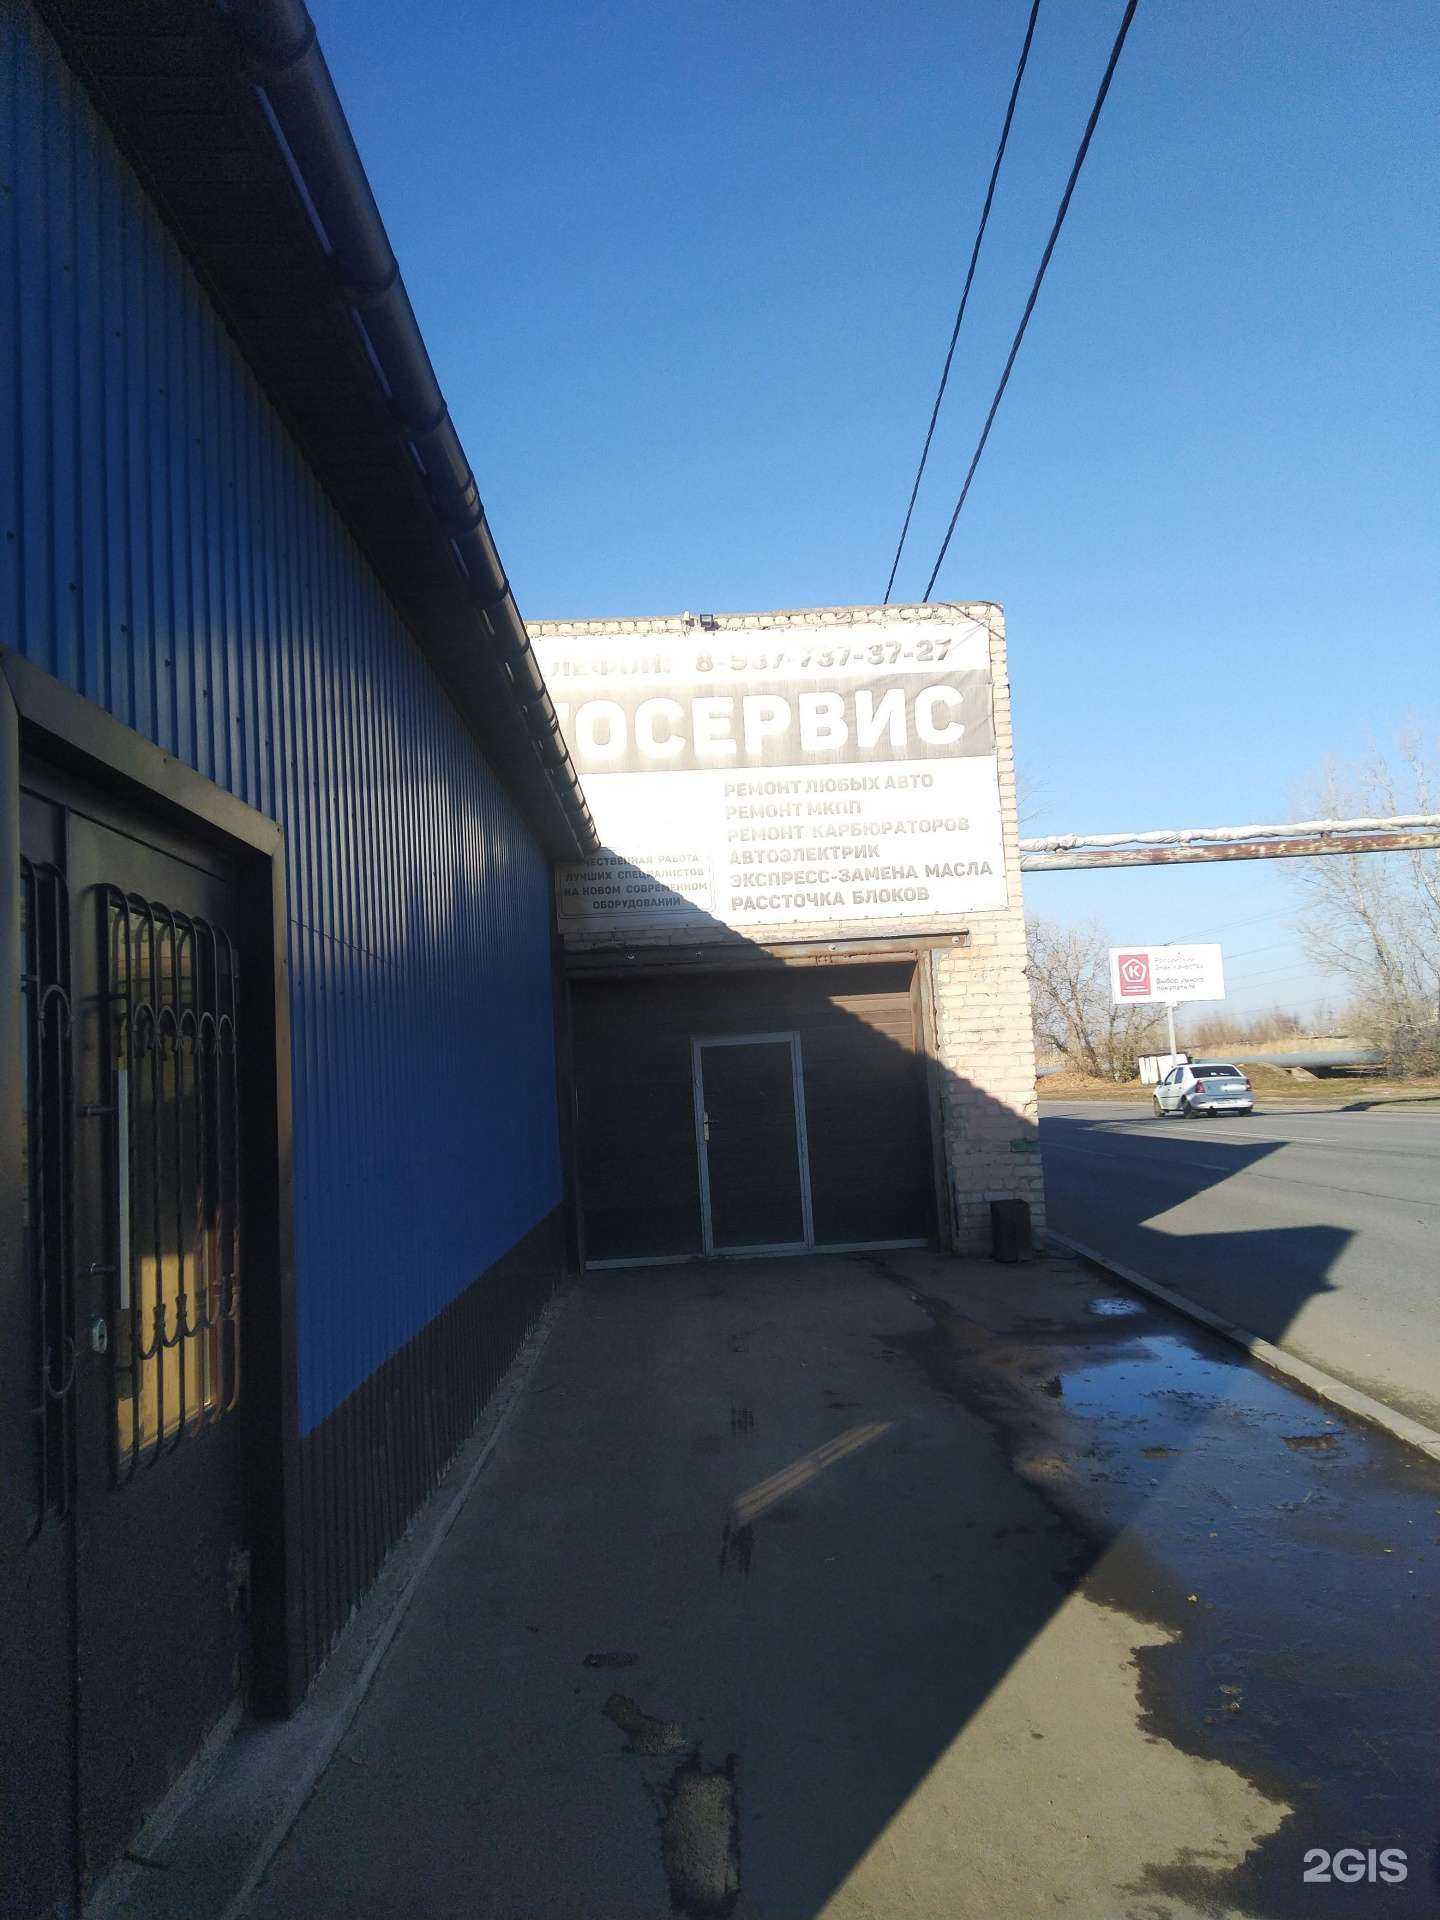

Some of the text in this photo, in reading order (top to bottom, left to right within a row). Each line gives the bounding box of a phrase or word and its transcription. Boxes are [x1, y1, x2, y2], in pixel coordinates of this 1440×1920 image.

[724, 772, 933, 797] РЕМОНТ ЛЮБЫХ АВТО
[725, 799, 863, 819] РЕМОНТ МКПП
[727, 816, 970, 842] РЕМОНТ КАРБЮРАТОРОВ
[657, 853, 699, 865] РАБОТА
[729, 844, 880, 865] АВТОЭЛЕКТРИК
[565, 867, 705, 882] ЛУЧШИХ СПЕЦИАЛИСТОВ
[730, 860, 994, 888] ЭКСПРЕСС-ЗАМЕНА МАСЛА
[564, 881, 708, 897] НА НОВОМ СОВРЕМЕННОМ
[731, 886, 930, 911] РАССТОЧКА БЛОКОВ
[592, 897, 681, 910] ОБОРУДОВАНИИ
